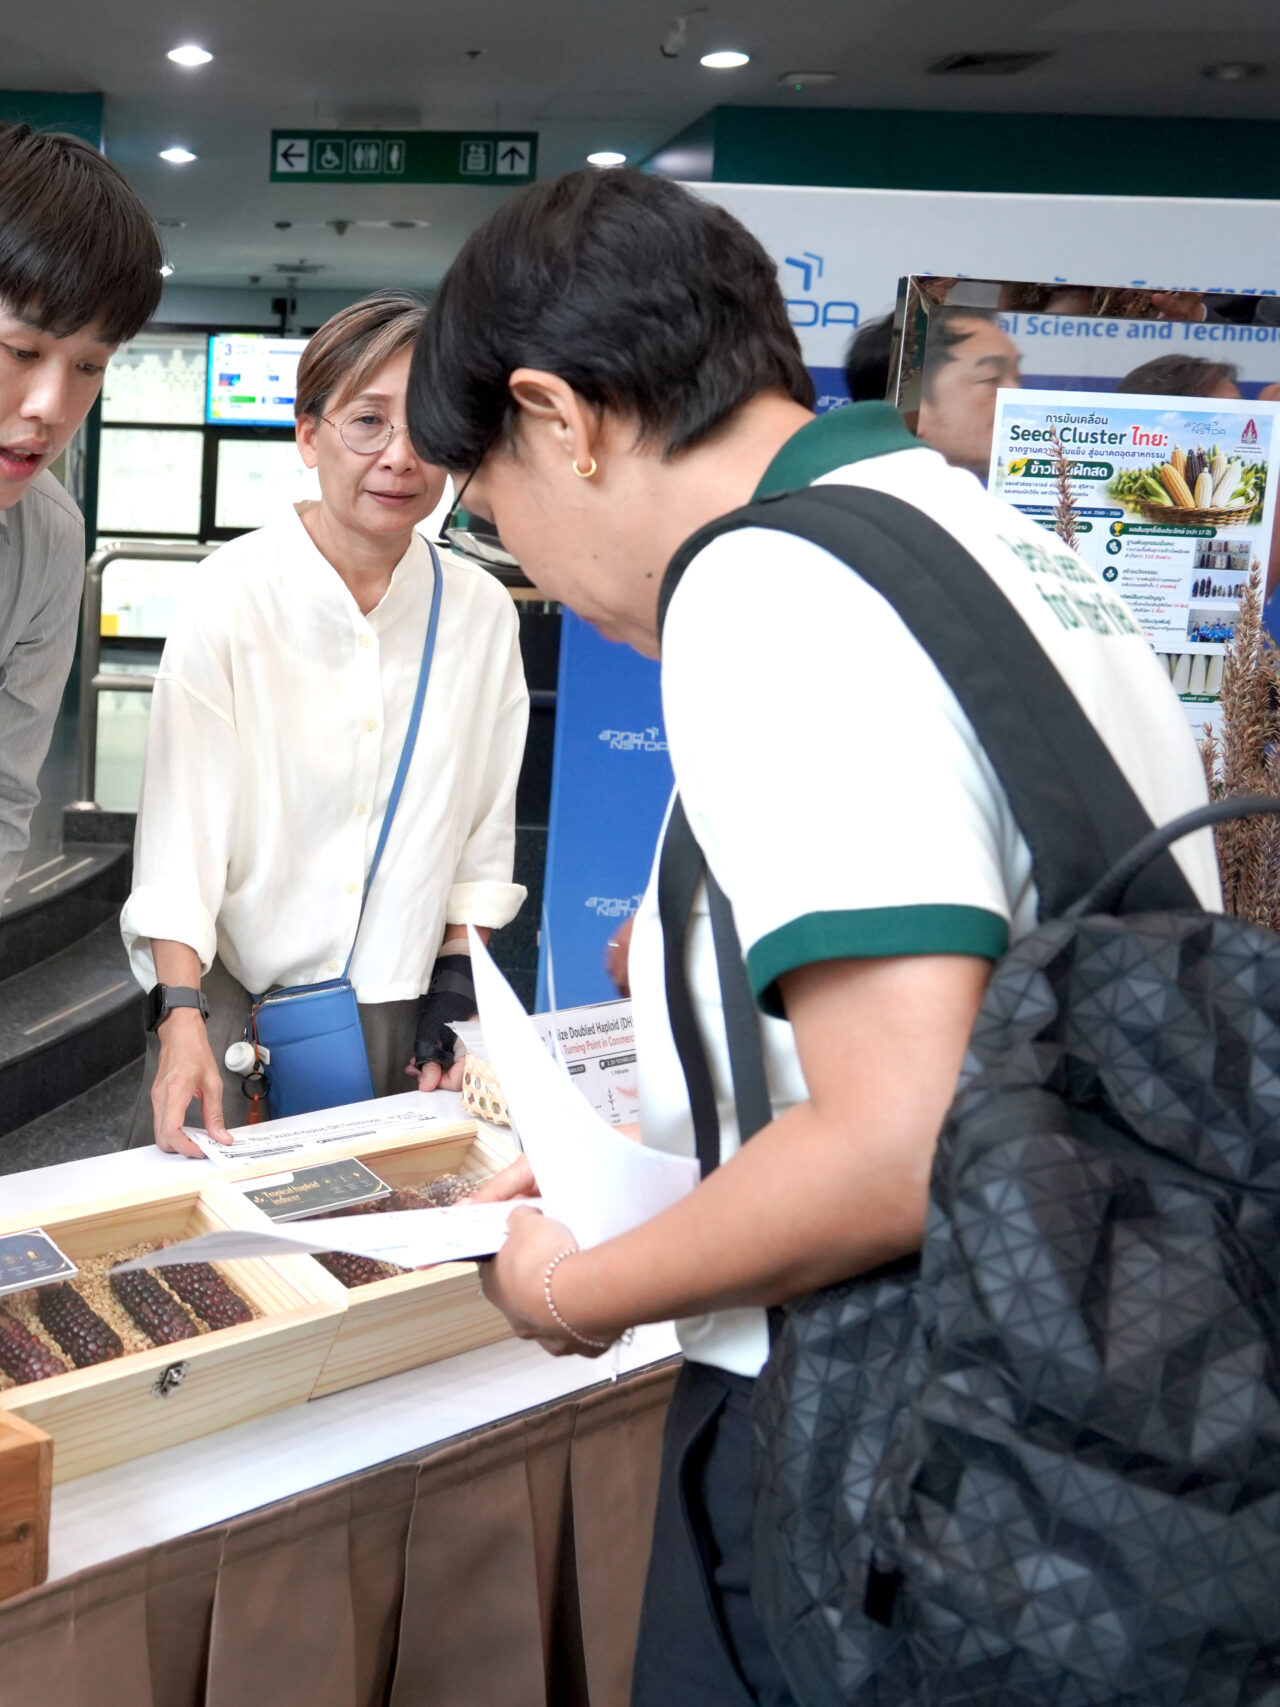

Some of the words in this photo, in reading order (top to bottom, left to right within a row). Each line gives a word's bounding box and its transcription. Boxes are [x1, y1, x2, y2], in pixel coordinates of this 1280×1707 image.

[1025, 316, 1119, 337] Science
[1126, 318, 1172, 339] and
[1183, 323, 1280, 343] Technol
[1046, 411, 1109, 425] การขับเคลื่อน
[1059, 427, 1127, 446] Cluster
[1132, 425, 1169, 447] ไทย:
[569, 1022, 596, 1039] Doubled
[596, 1019, 620, 1035] Haploid
[563, 1043, 586, 1056] Turning
[585, 1039, 602, 1051] Point
[602, 1039, 608, 1047] in
[608, 1034, 635, 1047] Commerc
[261, 1186, 293, 1199] Tropical
[293, 1181, 320, 1193] haploid
[271, 1195, 301, 1206] inducer
